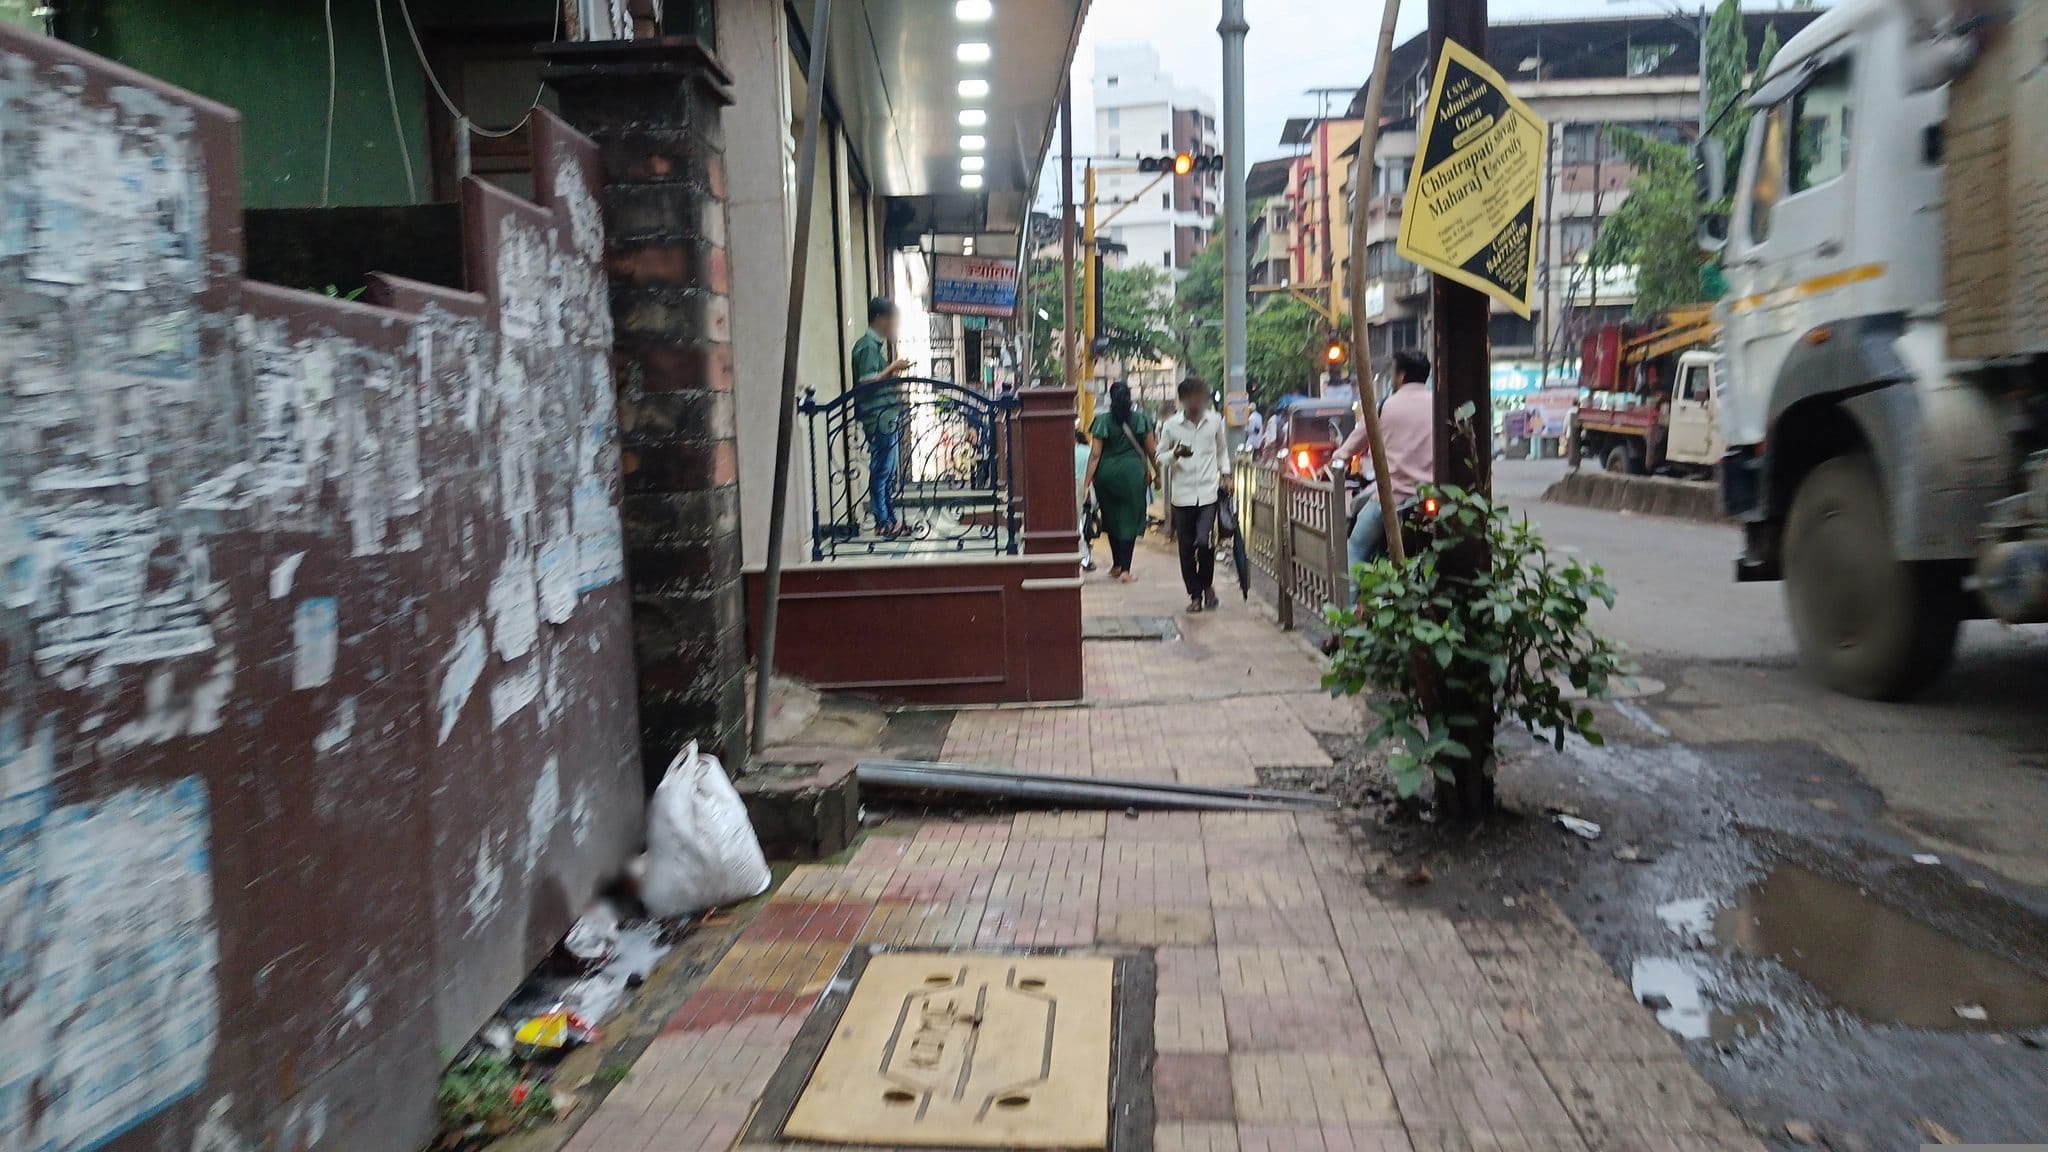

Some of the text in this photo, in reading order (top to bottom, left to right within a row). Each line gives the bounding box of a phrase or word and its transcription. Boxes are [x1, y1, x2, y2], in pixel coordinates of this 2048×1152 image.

[1439, 83, 1487, 122] Admission
[1455, 108, 1482, 132] Open
[1421, 138, 1494, 199] Chhatrapati
[1429, 174, 1483, 220] Maharaj
